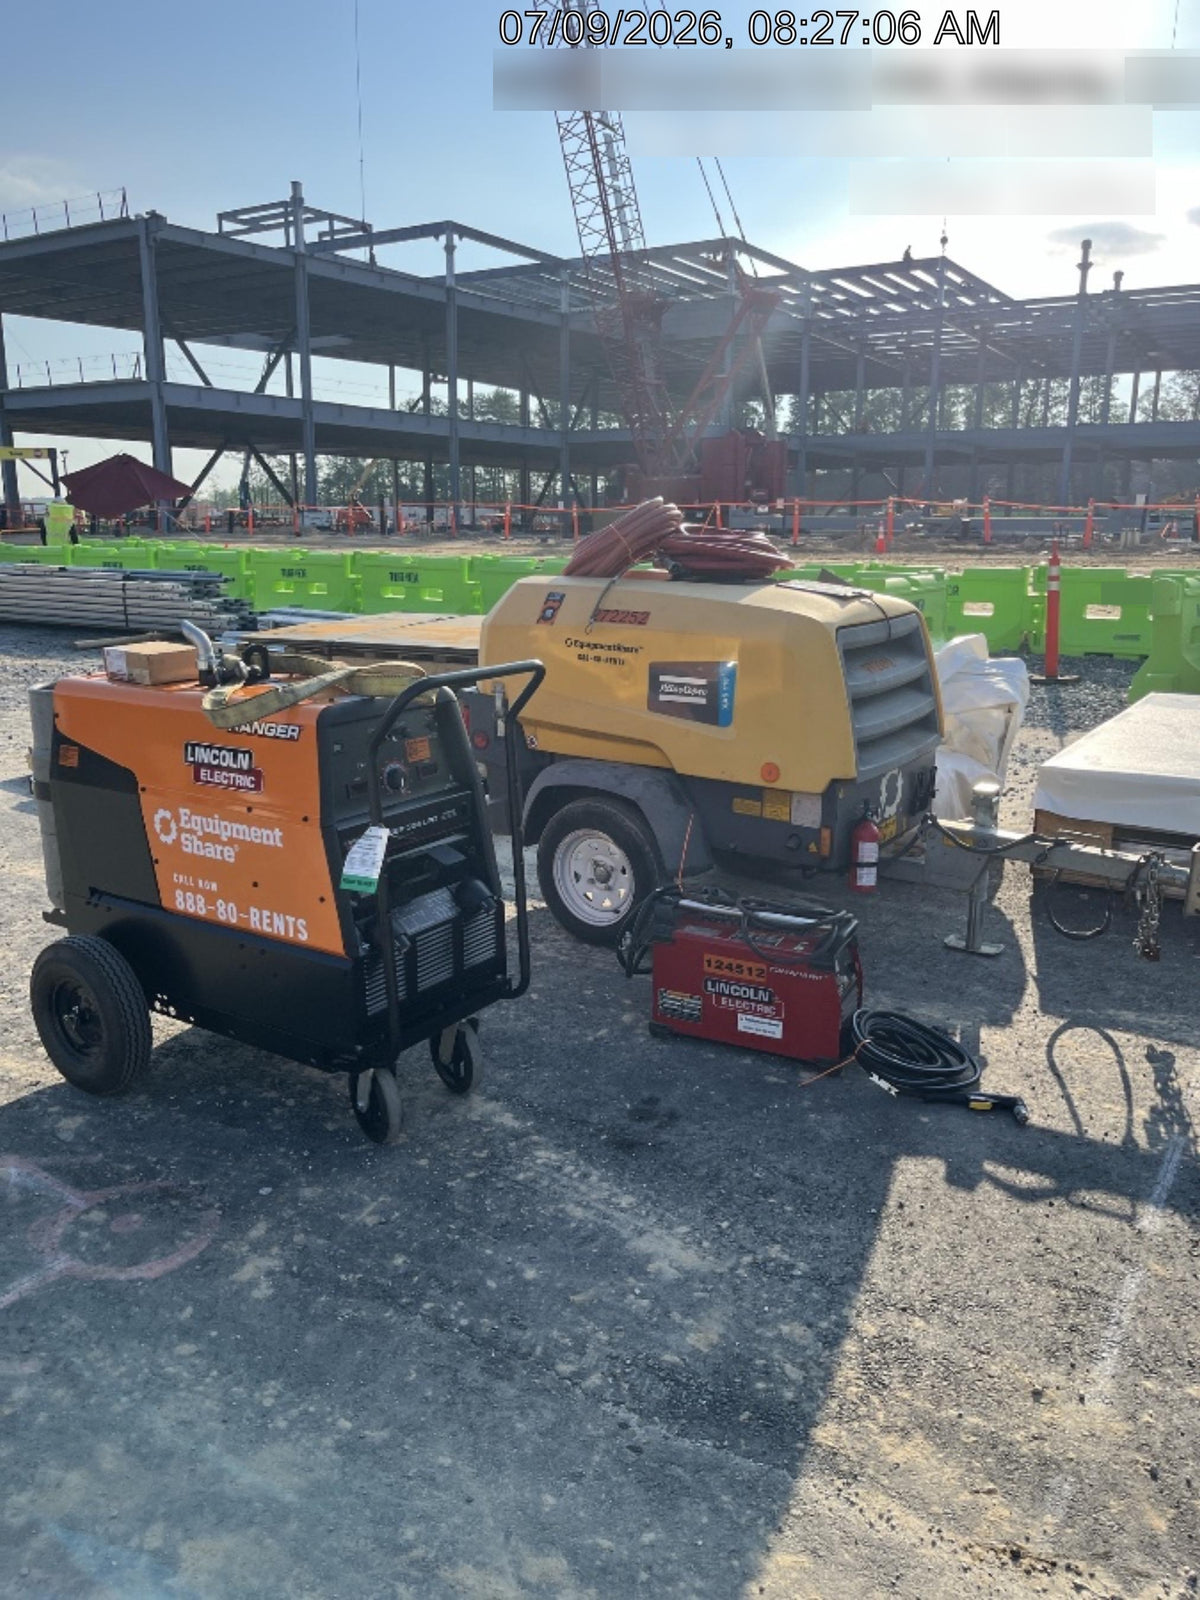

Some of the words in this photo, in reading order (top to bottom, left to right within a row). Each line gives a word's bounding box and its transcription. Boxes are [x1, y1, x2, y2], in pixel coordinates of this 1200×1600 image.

[592, 609, 650, 626] 72252
[228, 721, 300, 740] ANGER
[187, 745, 250, 770] LINCOLN
[200, 768, 255, 788] ELECTRIC
[178, 807, 284, 848] Equipment
[180, 833, 236, 863] Share
[175, 889, 309, 941] 888-80-RENTS
[705, 957, 766, 979] 124512
[706, 979, 770, 1002] LINCOLN
[720, 996, 777, 1016] ELECTRIC
